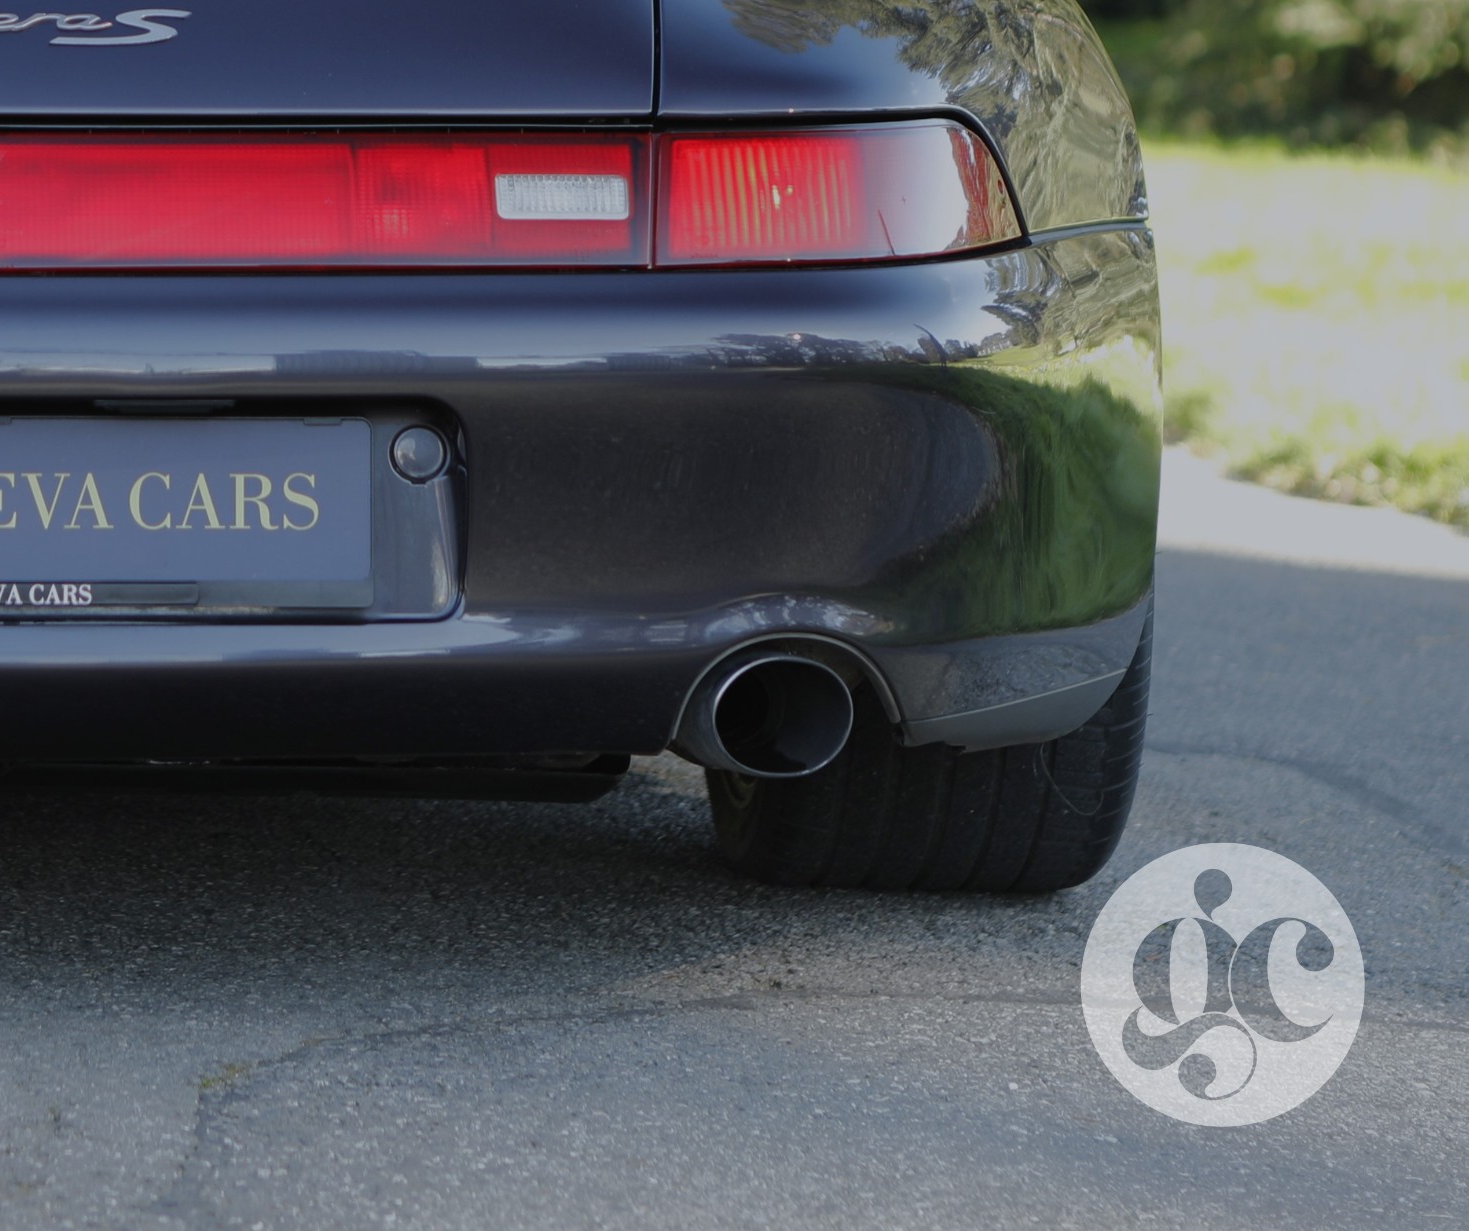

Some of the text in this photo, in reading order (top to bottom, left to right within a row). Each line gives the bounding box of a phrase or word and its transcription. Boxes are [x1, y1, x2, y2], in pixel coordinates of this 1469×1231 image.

[49, 8, 192, 46] S
[130, 471, 319, 530] CARS
[29, 583, 93, 605] CARS
